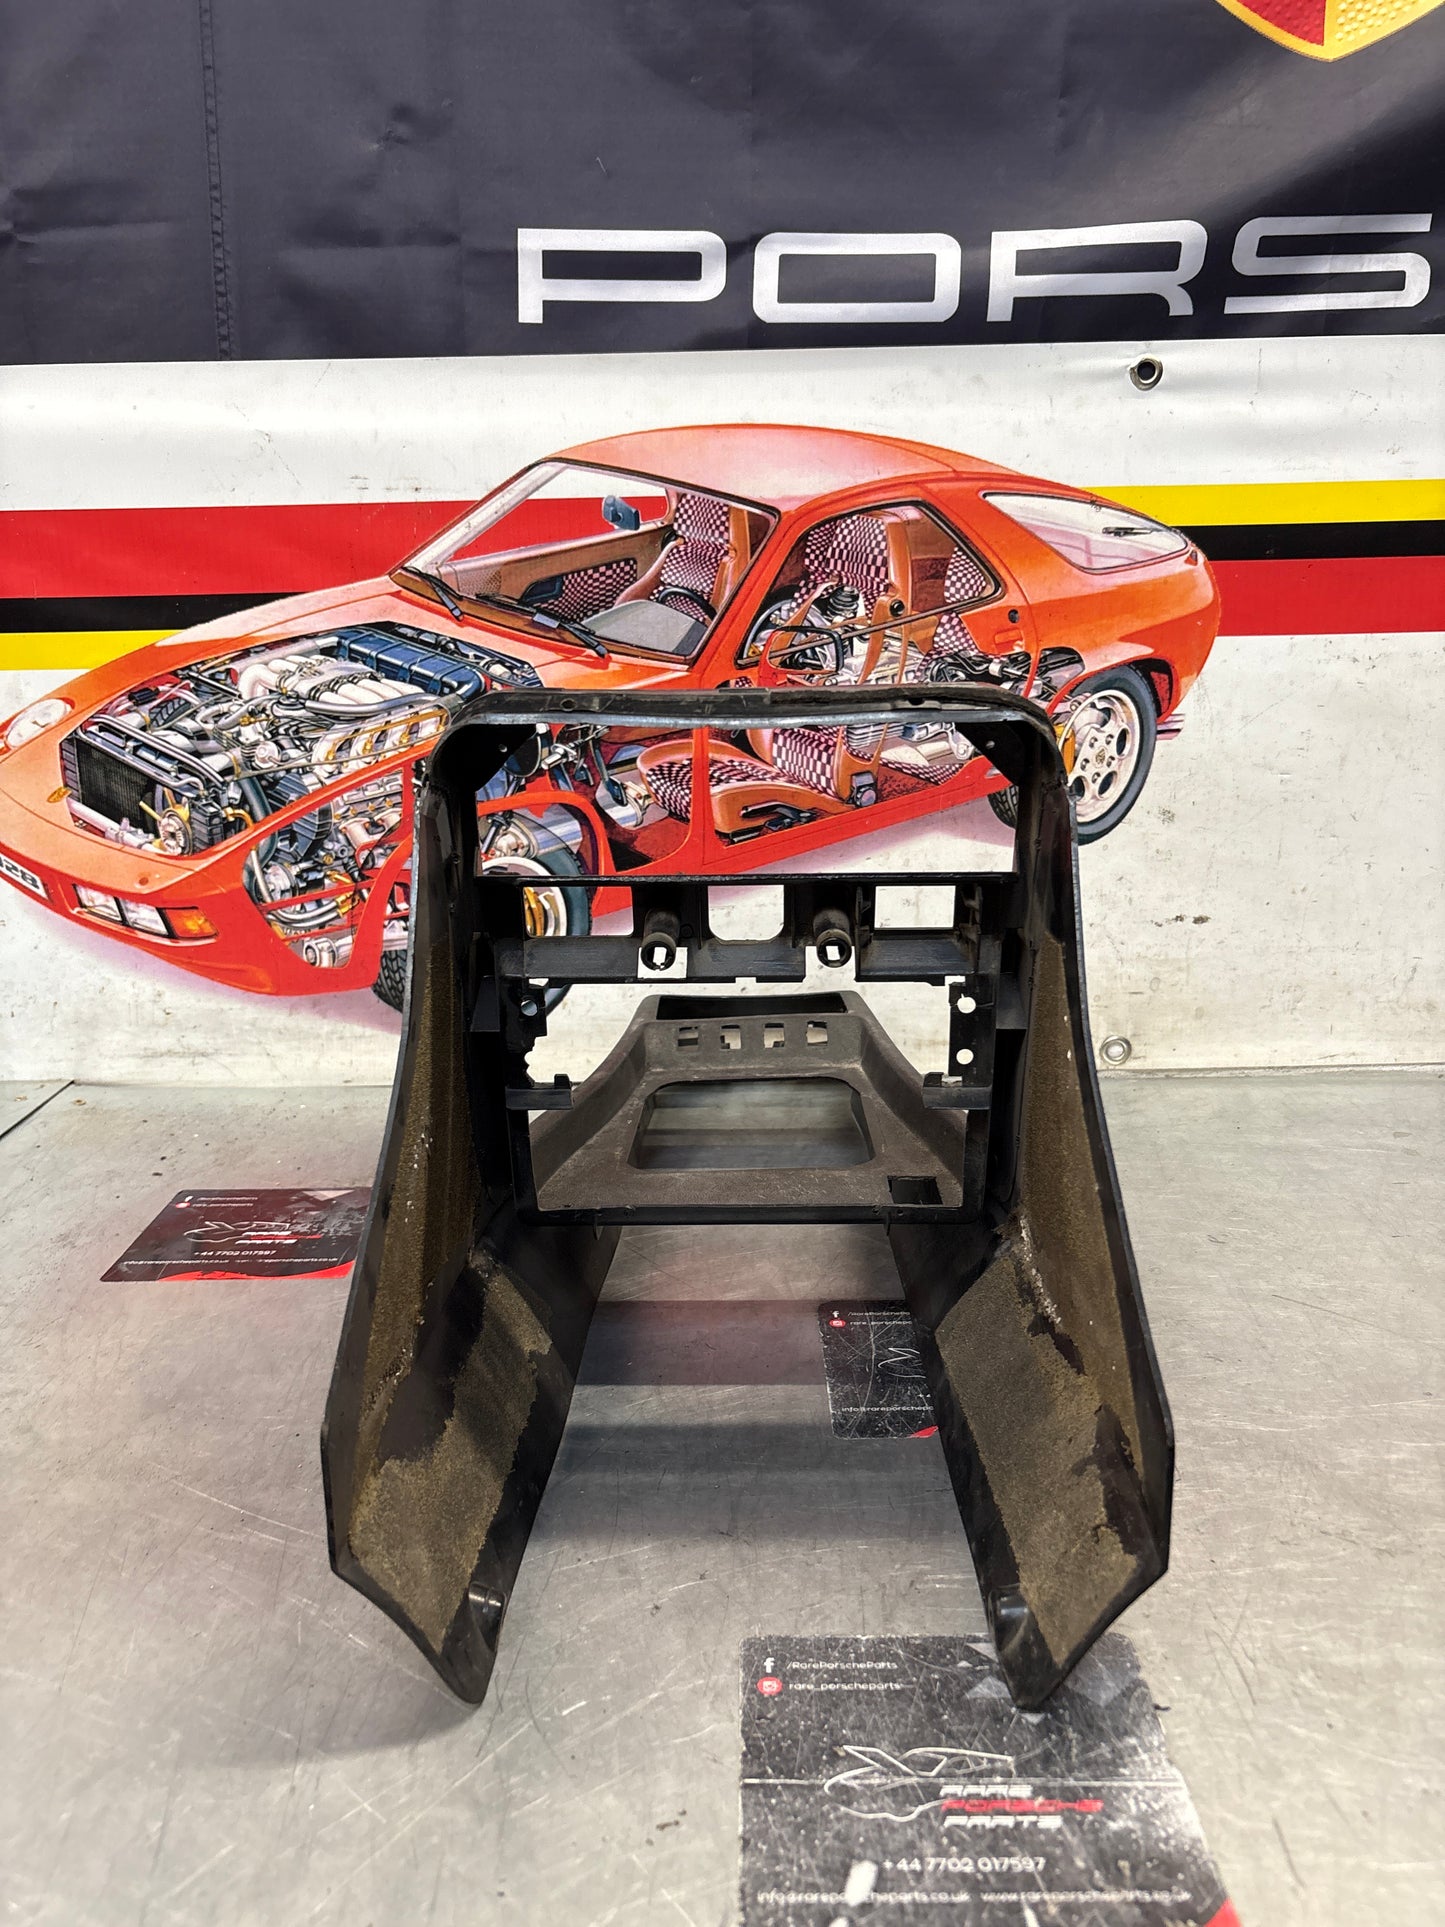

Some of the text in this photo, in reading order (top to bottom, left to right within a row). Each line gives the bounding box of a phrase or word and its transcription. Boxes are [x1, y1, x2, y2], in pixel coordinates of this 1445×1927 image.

[518, 213, 1432, 323] PORS
[925, 1857, 975, 1873] 7702
[977, 1856, 1046, 1873] 017597
